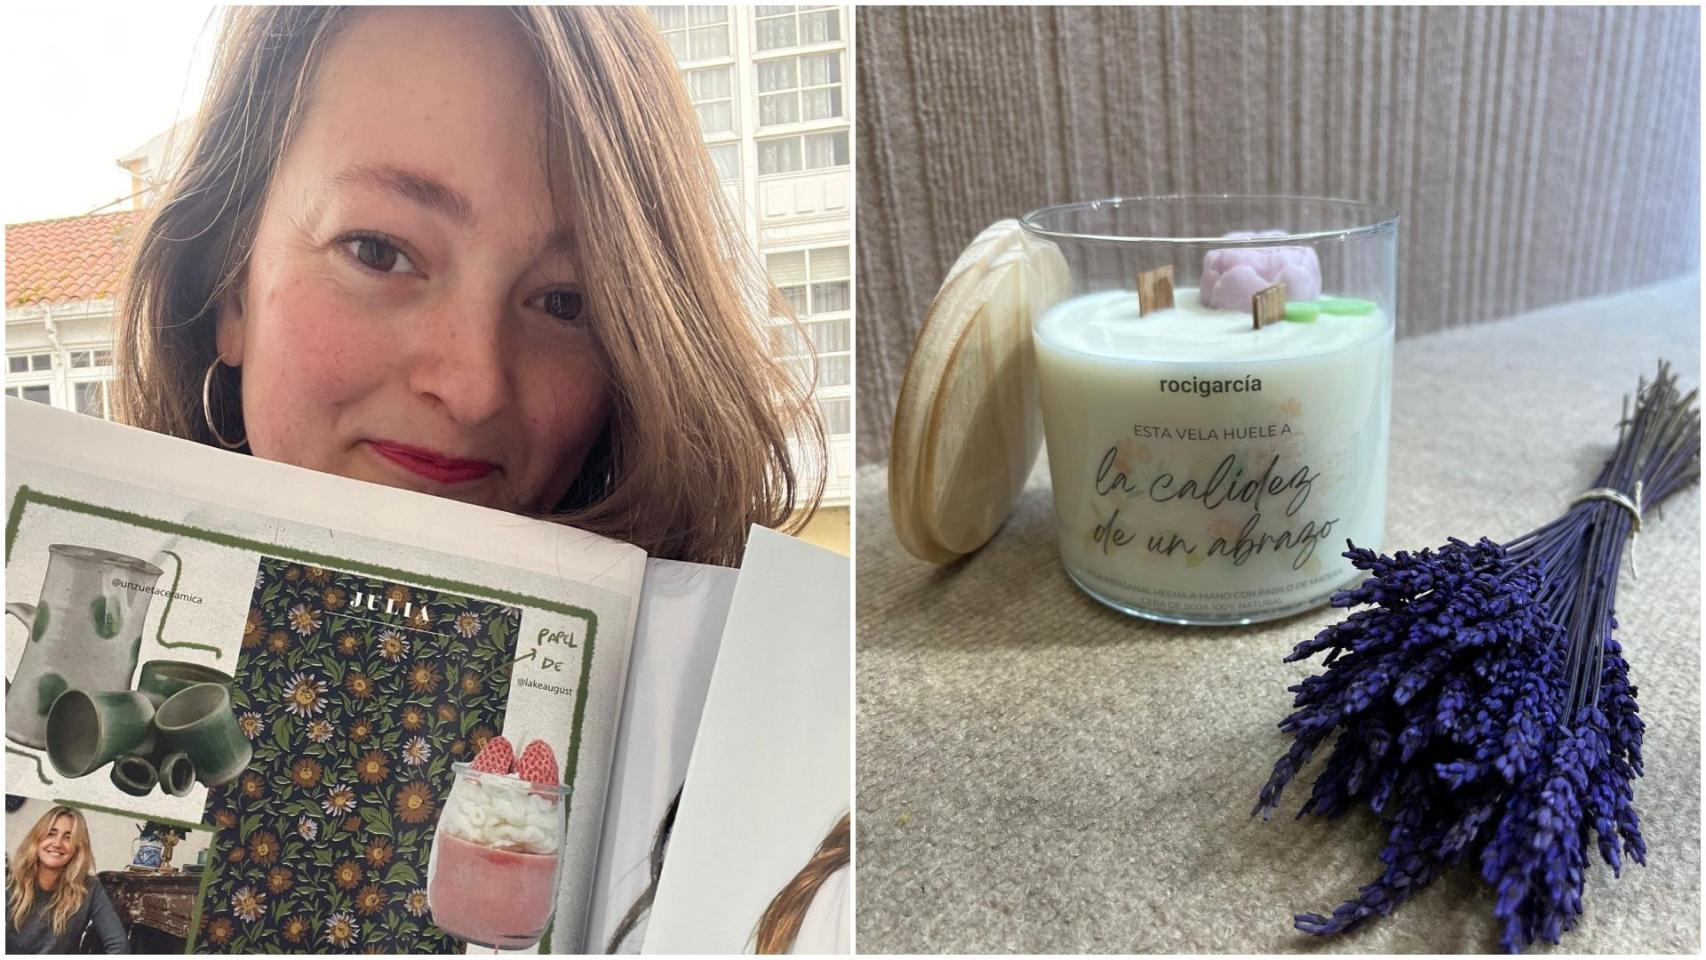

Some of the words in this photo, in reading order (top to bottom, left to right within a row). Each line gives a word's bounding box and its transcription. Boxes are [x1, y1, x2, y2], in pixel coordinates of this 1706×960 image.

[1160, 374, 1262, 397] rocigarcía
[1134, 425, 1172, 439] ESTA
[1176, 428, 1219, 440] VELA
[1224, 425, 1277, 440] HUELE
[1281, 423, 1292, 435] A
[1095, 446, 1136, 496] la
[1149, 454, 1320, 517] calidez
[1094, 509, 1136, 555] de
[1148, 534, 1197, 557] un
[1207, 512, 1340, 570] abrazo
[112, 578, 203, 604] @unzuetaceamica
[1153, 588, 1188, 598] HECHA
[1189, 592, 1197, 600] A
[1200, 591, 1231, 600] MANO
[1233, 590, 1256, 600] CON
[350, 591, 430, 622] JULIA
[537, 628, 578, 648] PAPEL
[541, 657, 564, 671] DE
[517, 678, 573, 696] @lakeaugust
